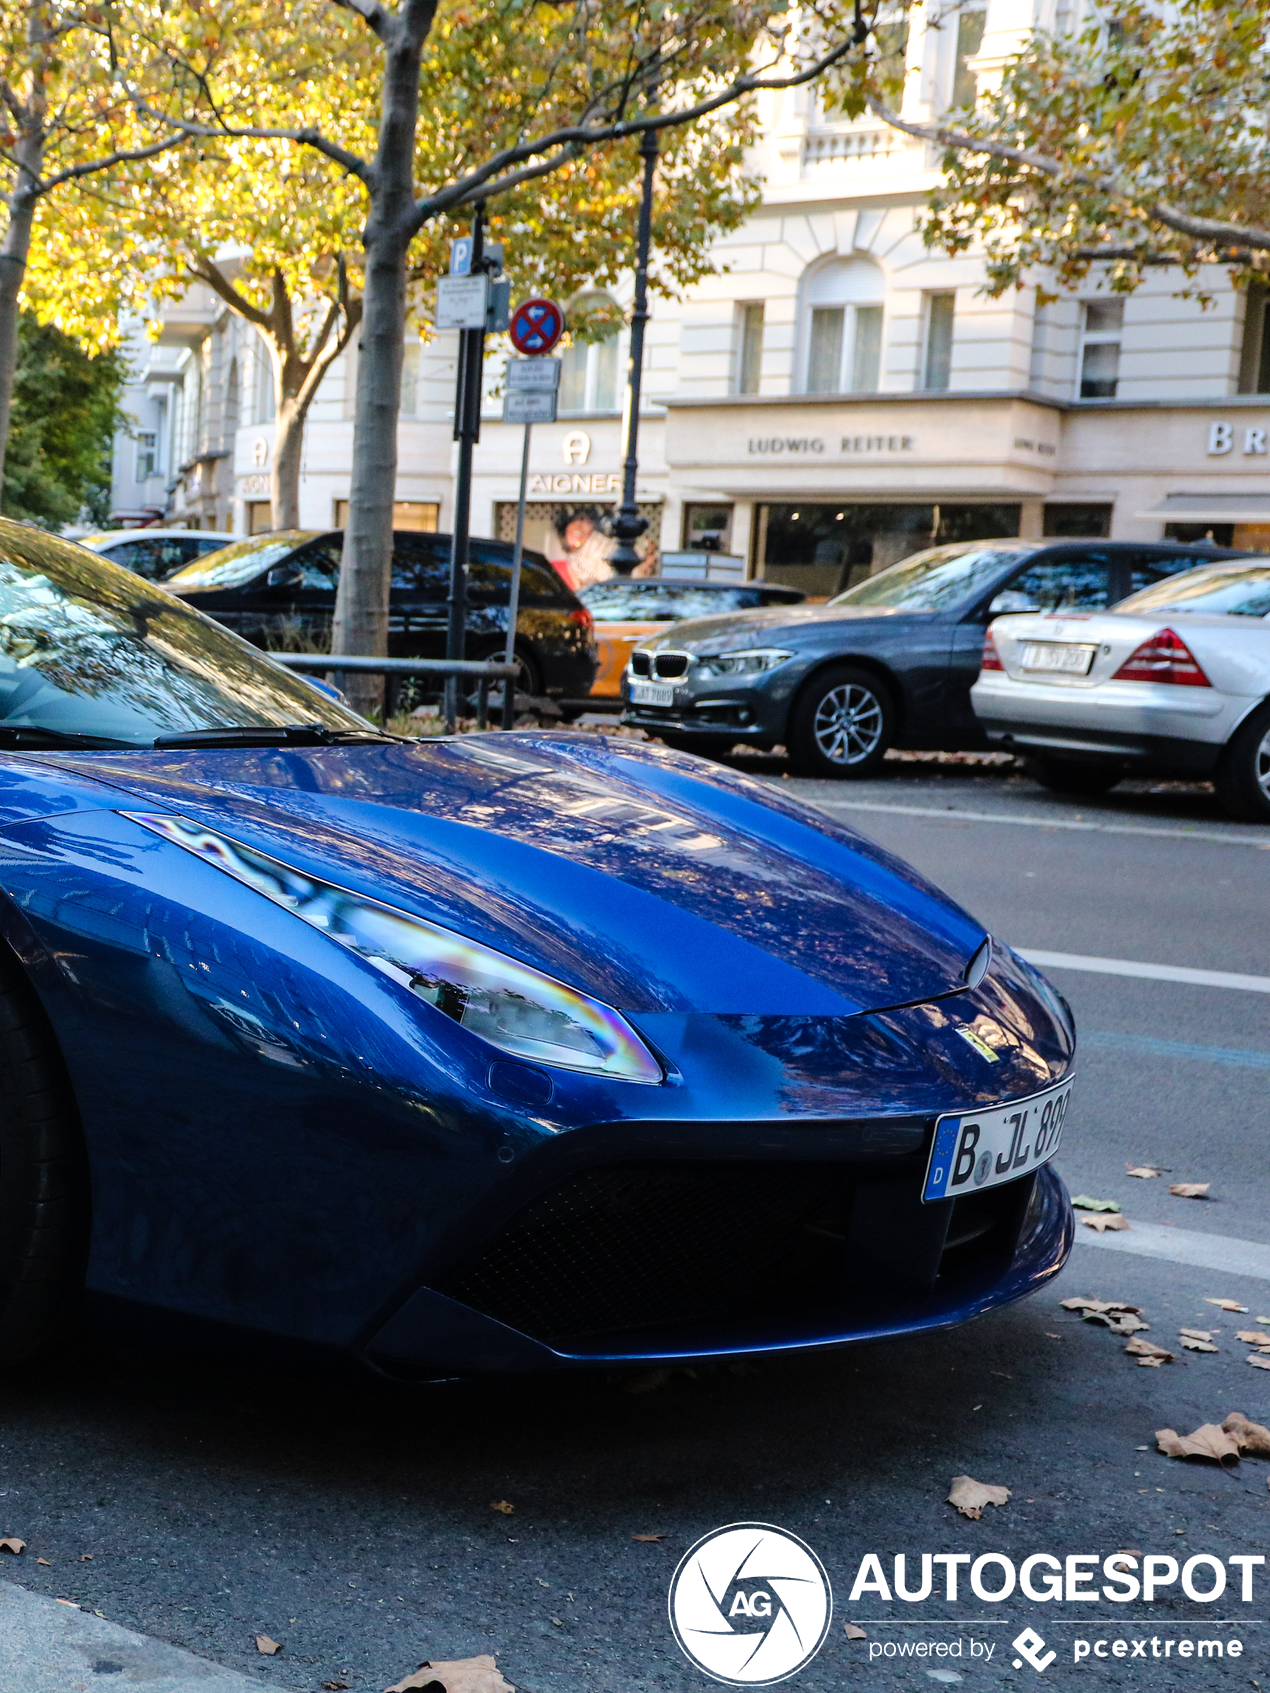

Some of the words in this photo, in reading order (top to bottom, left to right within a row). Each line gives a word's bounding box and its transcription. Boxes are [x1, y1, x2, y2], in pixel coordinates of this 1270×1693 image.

[454, 242, 467, 269] P
[563, 431, 590, 465] A
[748, 437, 825, 454] LUDWIG
[841, 435, 914, 453] REITER
[951, 1123, 981, 1186] B
[995, 1110, 1030, 1175] JL
[1034, 1089, 1071, 1159] 899
[933, 1167, 944, 1184] D
